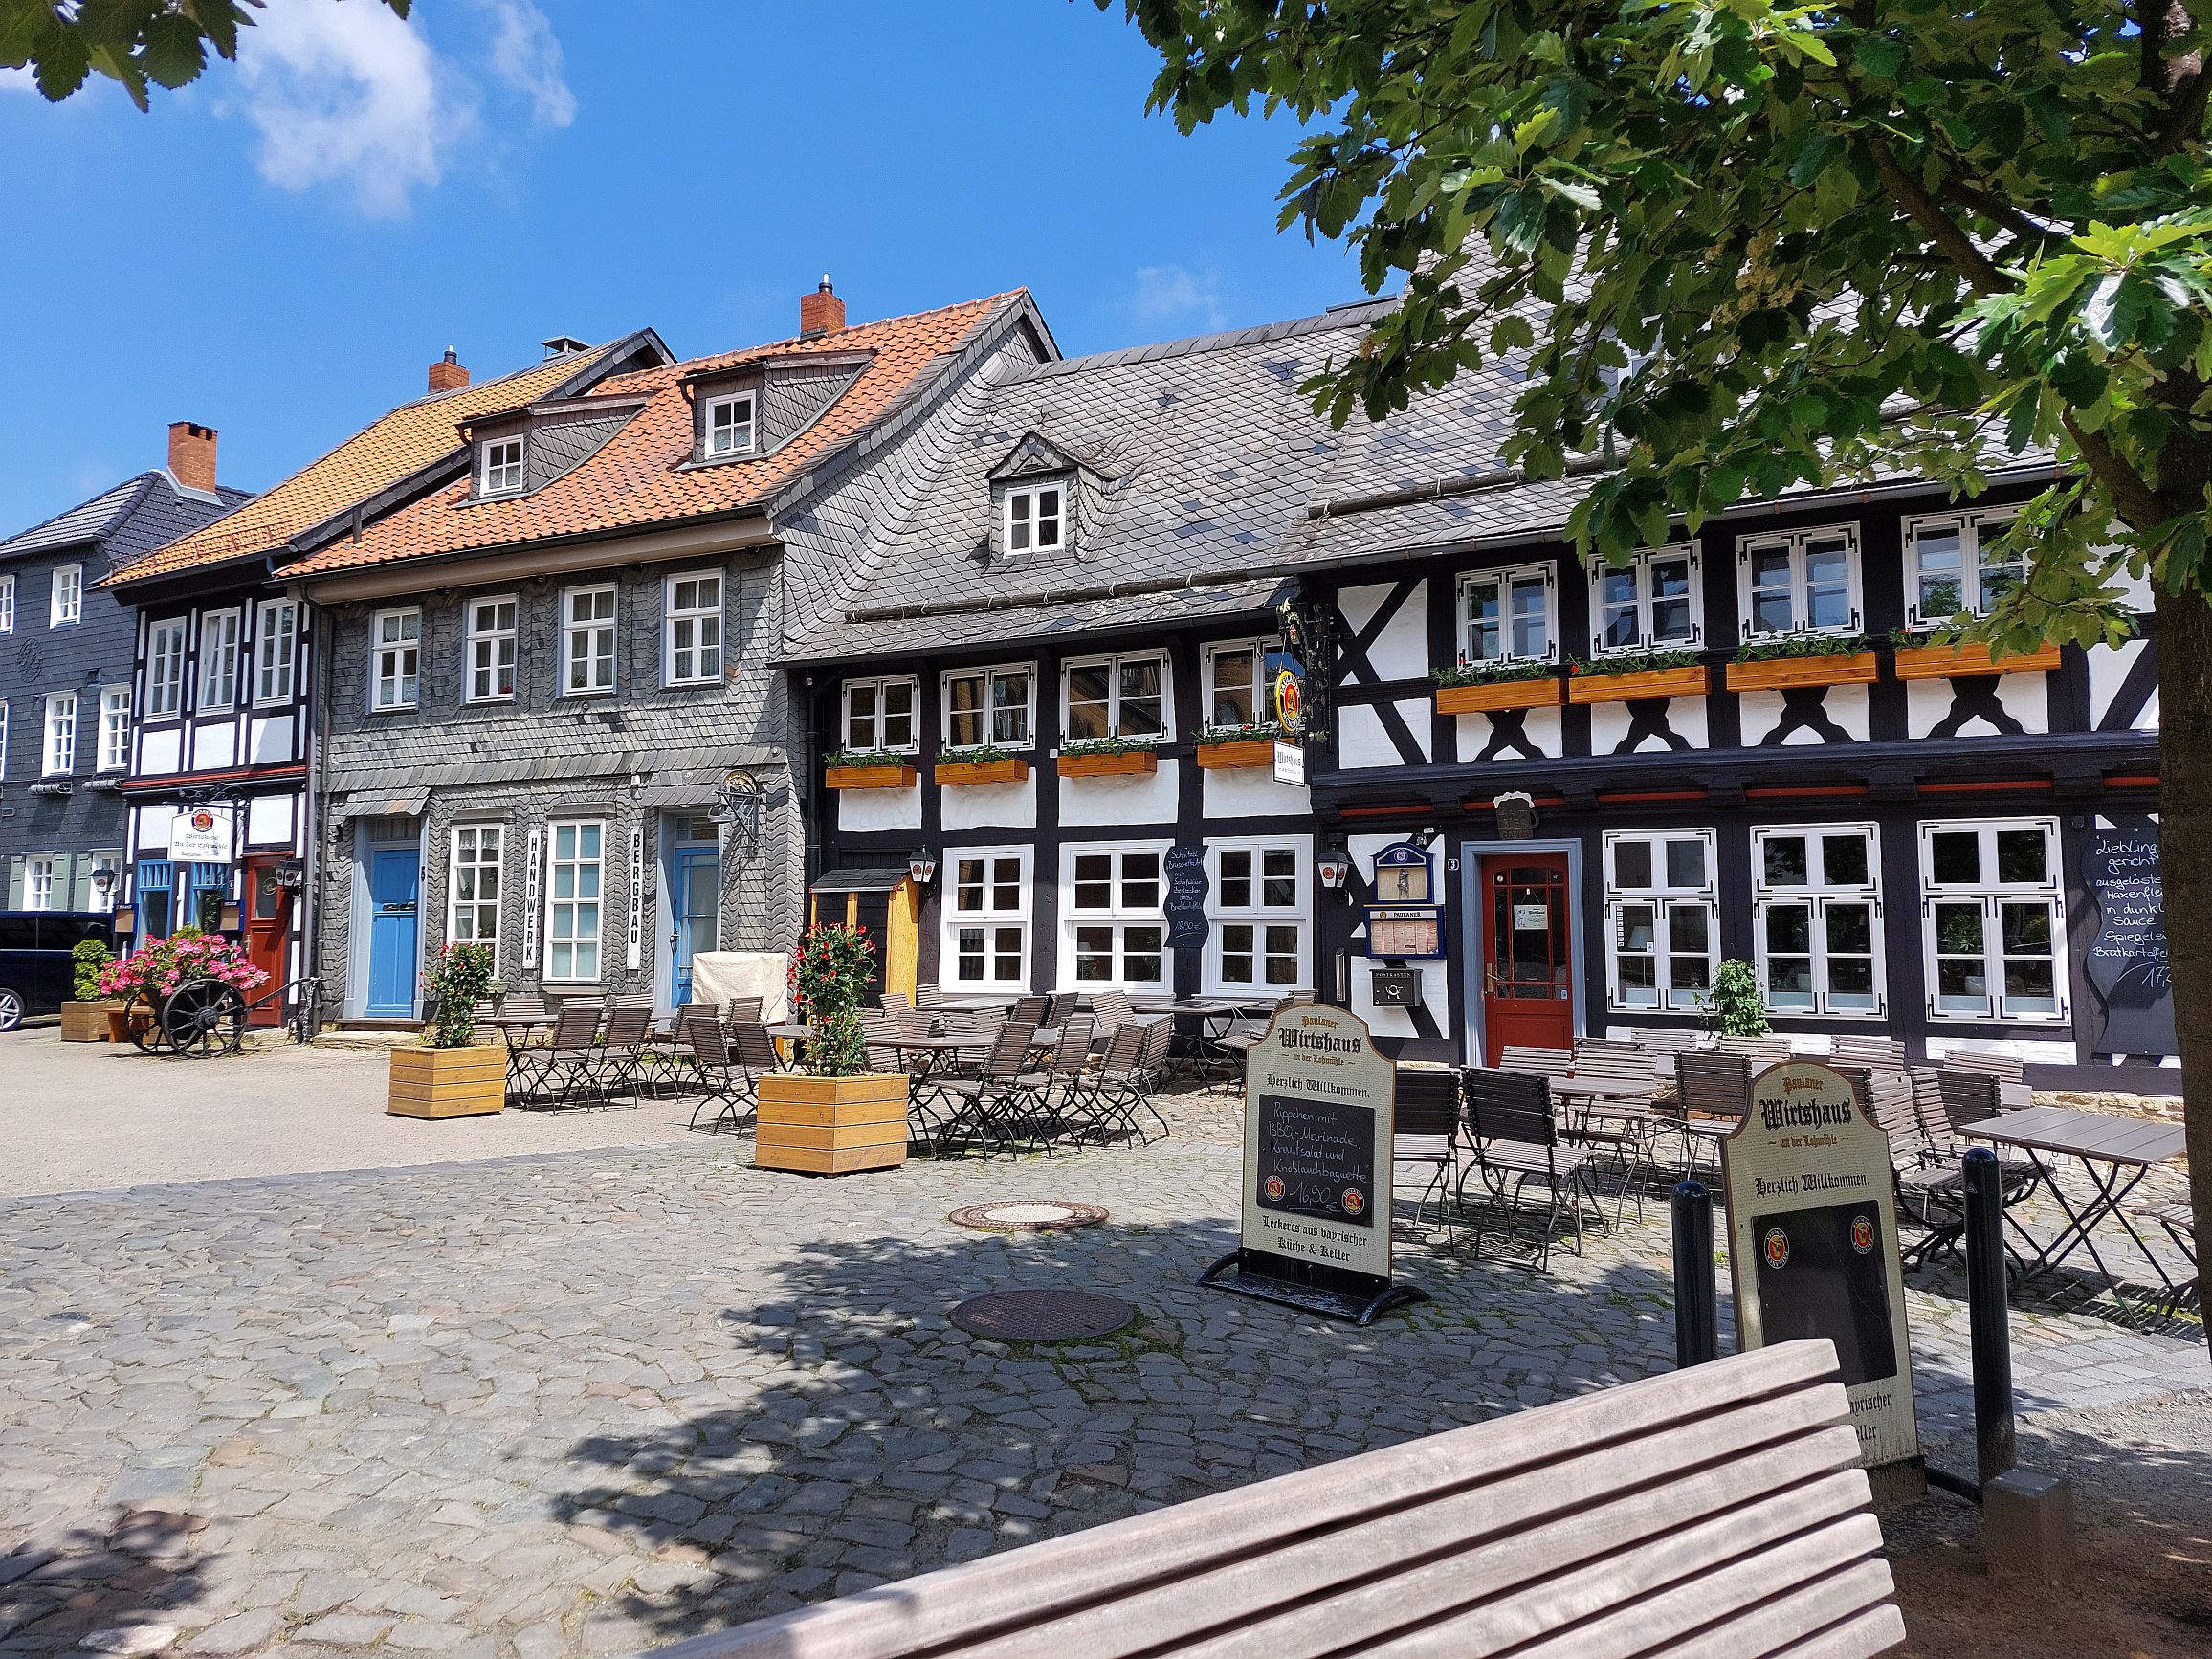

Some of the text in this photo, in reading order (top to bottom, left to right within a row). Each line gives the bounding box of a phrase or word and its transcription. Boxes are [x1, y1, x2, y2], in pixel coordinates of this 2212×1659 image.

[525, 837, 538, 961] HANDWERK
[630, 833, 641, 944] BERGBAU
[2113, 916, 2157, 927] Sauce
[1301, 1015, 1338, 1029] Paulaner
[1278, 1027, 1362, 1054] Wirtshaus
[1301, 1053, 1312, 1062] der
[1313, 1054, 1344, 1066] Lohmühle
[1267, 1073, 1371, 1098] Herzlich Willkommen.
[1782, 1075, 1824, 1095] Paulaner
[1273, 1101, 1338, 1125] Rippchen mit
[1758, 1097, 1852, 1131] Wirtshaus
[1325, 1148, 1345, 1161] und
[1781, 1138, 1791, 1148] an
[1791, 1136, 1803, 1147] der
[1755, 1172, 1870, 1199] Herzlich Willkommen.
[1263, 1215, 1368, 1247] Leckeres aus bayrischer
[1277, 1236, 1351, 1262] Küche & Keller
[1849, 1391, 1891, 1417] ayrischer
[1856, 1425, 1877, 1441] eller
